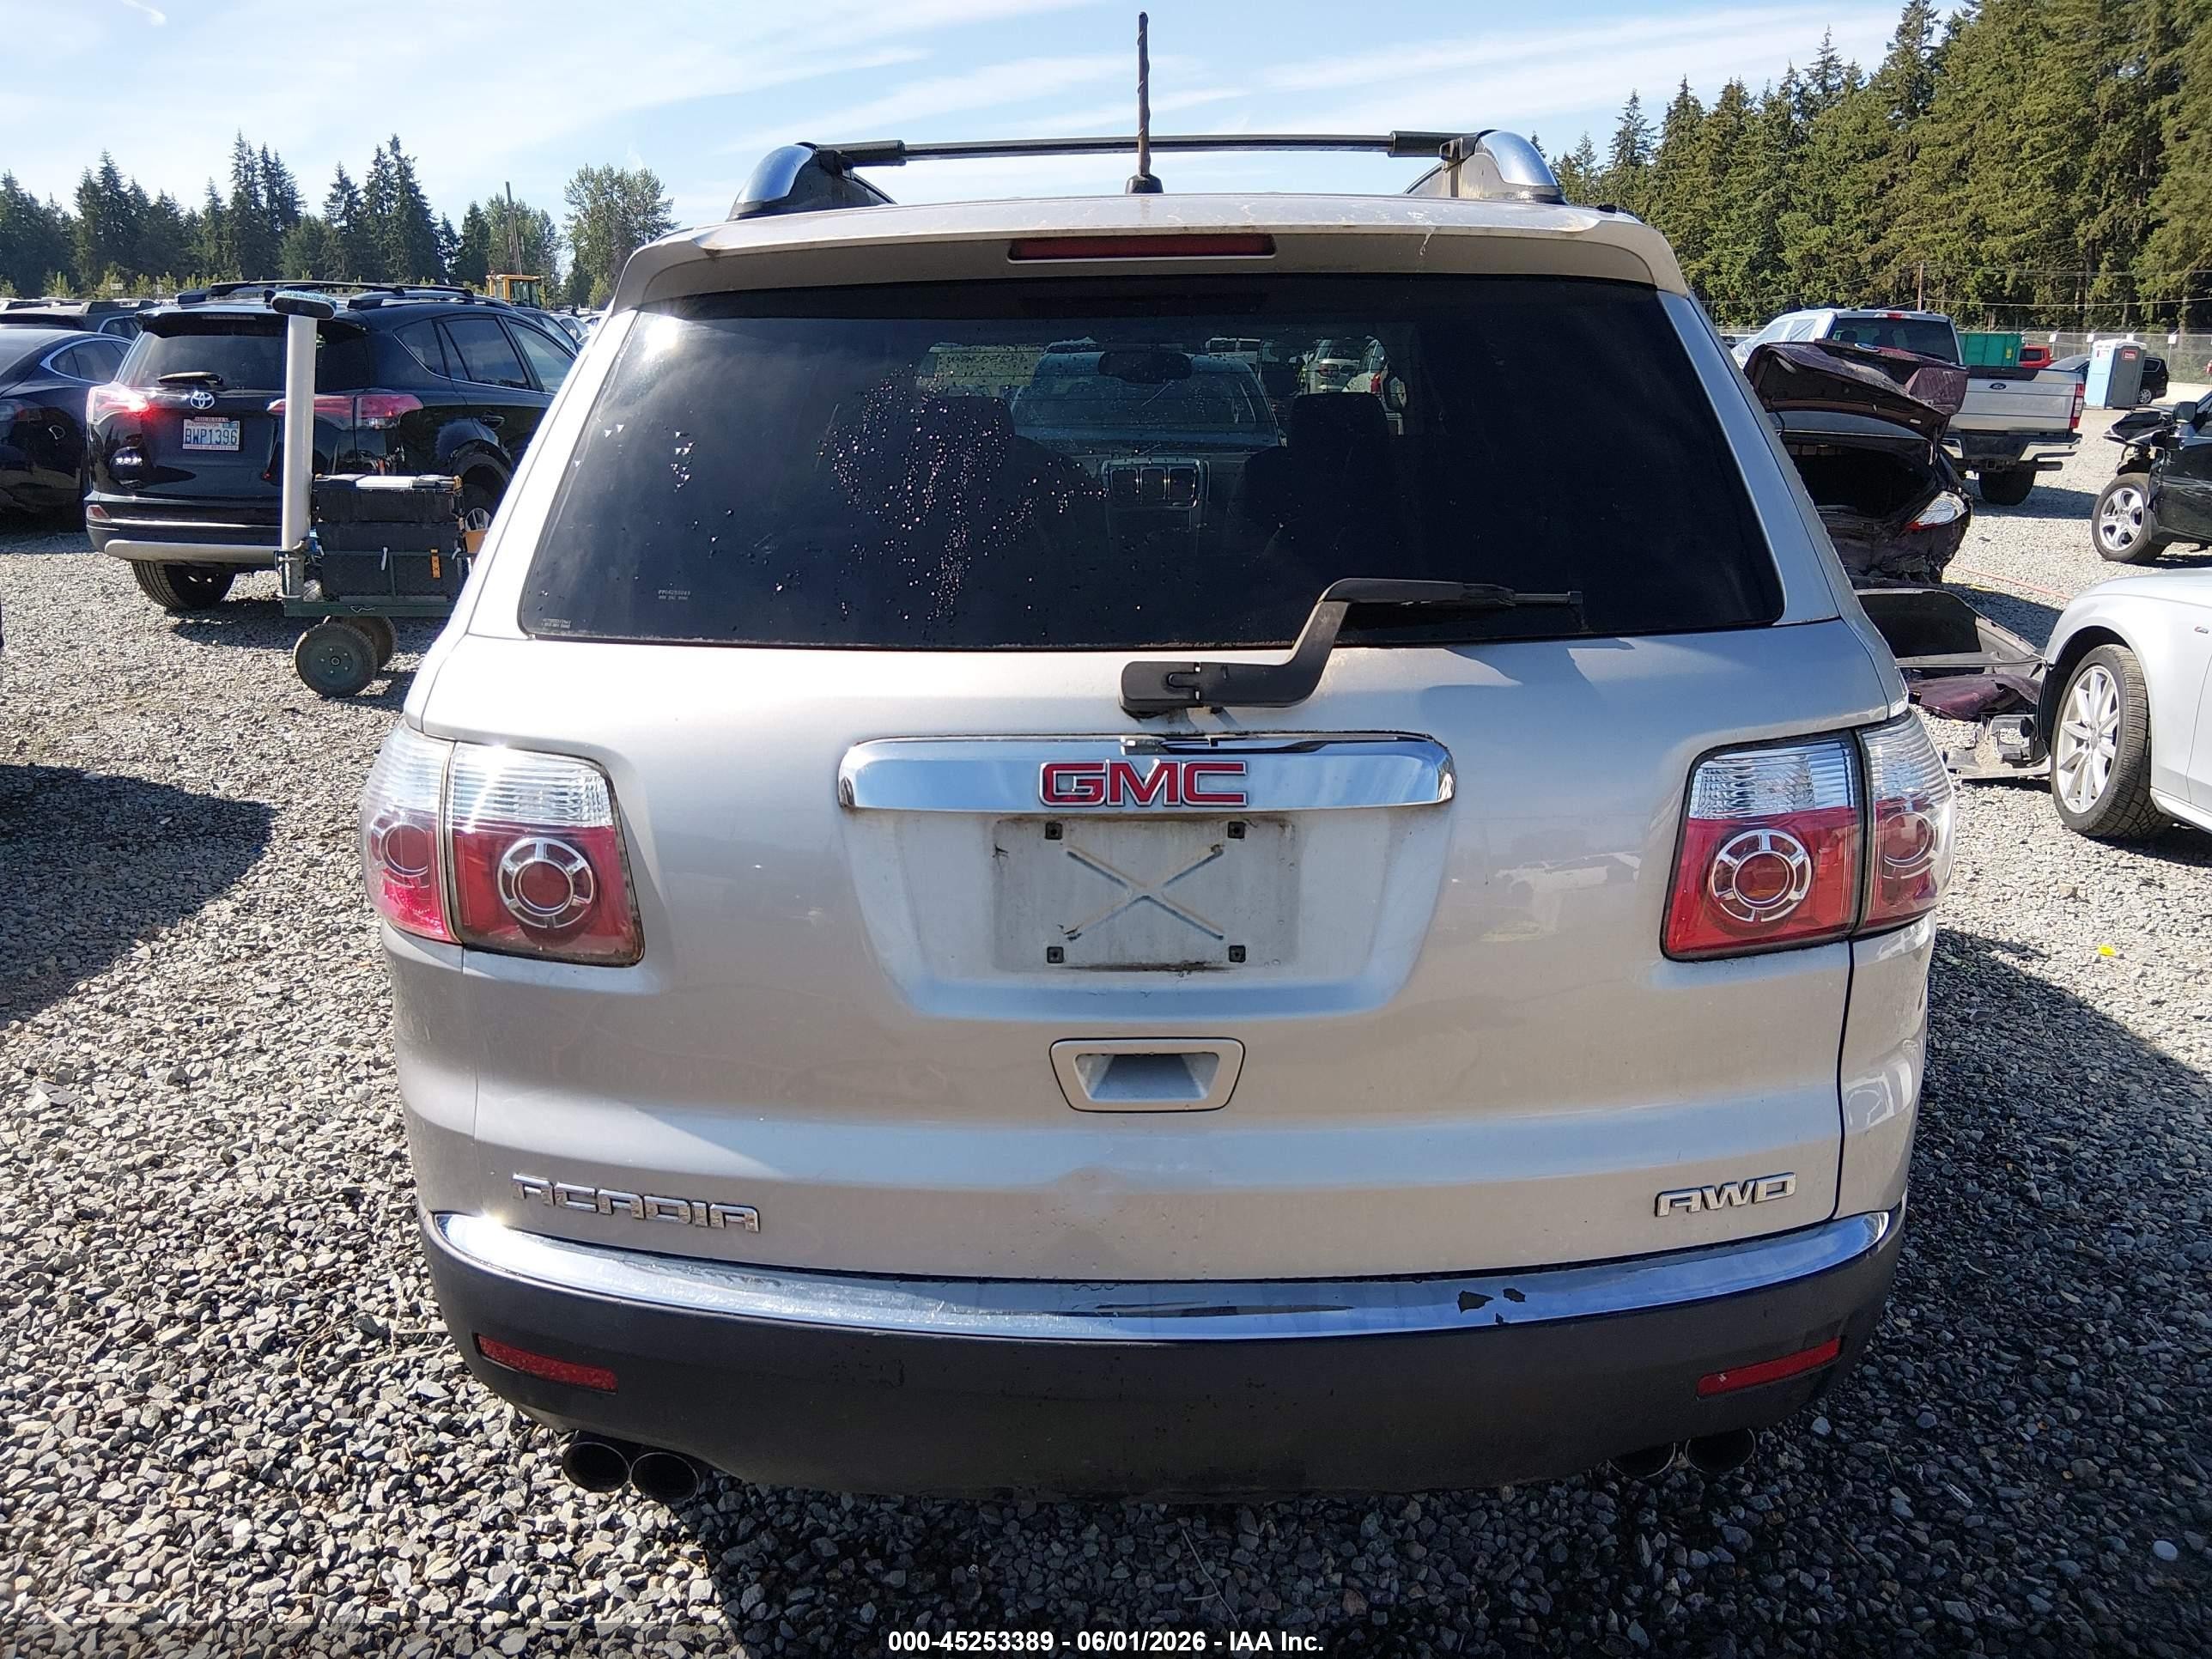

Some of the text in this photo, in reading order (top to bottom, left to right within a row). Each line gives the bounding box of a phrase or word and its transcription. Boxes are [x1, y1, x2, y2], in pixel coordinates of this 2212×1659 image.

[185, 428, 238, 446] BWP1396
[1040, 759, 1248, 807] GMC
[512, 1173, 761, 1233] ACADIA
[1655, 1172, 1797, 1218] AWD
